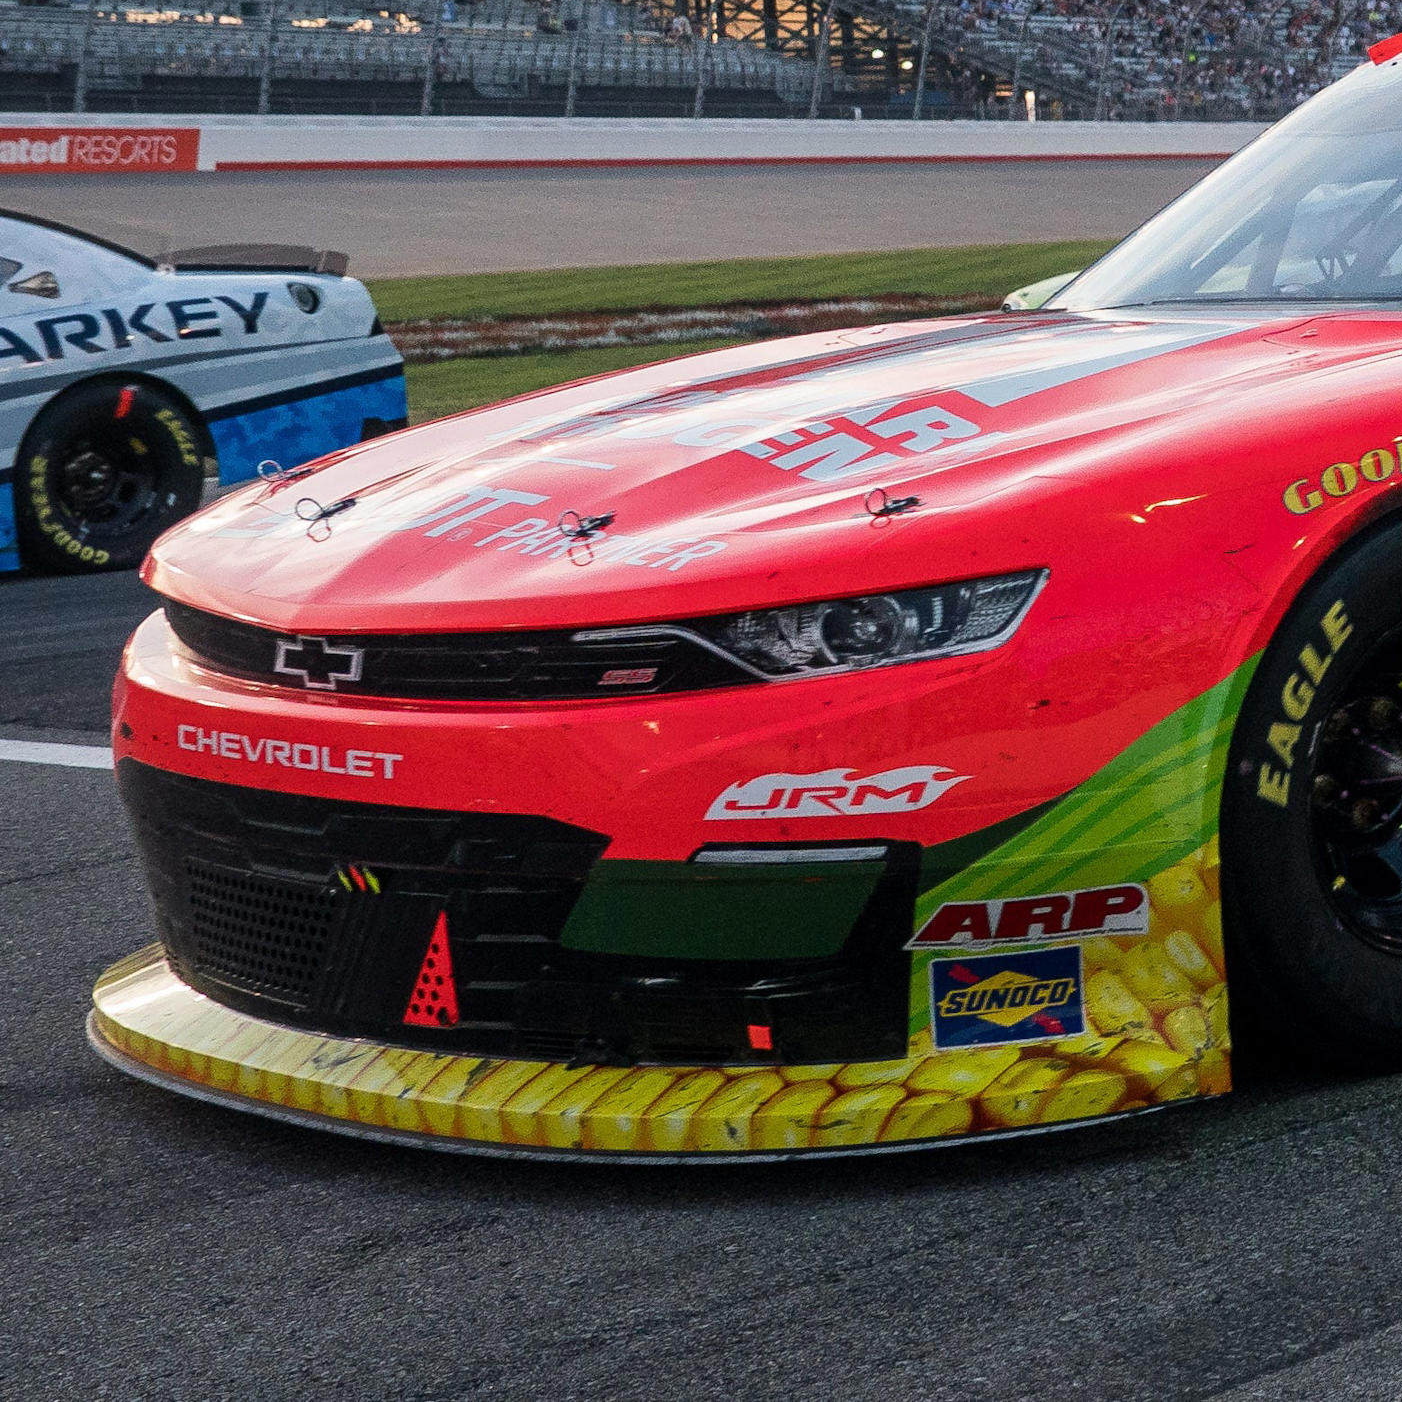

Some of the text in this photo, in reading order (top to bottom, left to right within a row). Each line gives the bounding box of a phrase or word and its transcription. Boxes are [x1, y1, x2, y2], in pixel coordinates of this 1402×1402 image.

[73, 135, 177, 165] RESORTS
[1256, 598, 1355, 808] EAGLE
[177, 723, 403, 781] CHEVROLET
[724, 779, 931, 816] JRM
[914, 885, 1145, 942] ARP
[939, 979, 1076, 1017] SUNOCO
